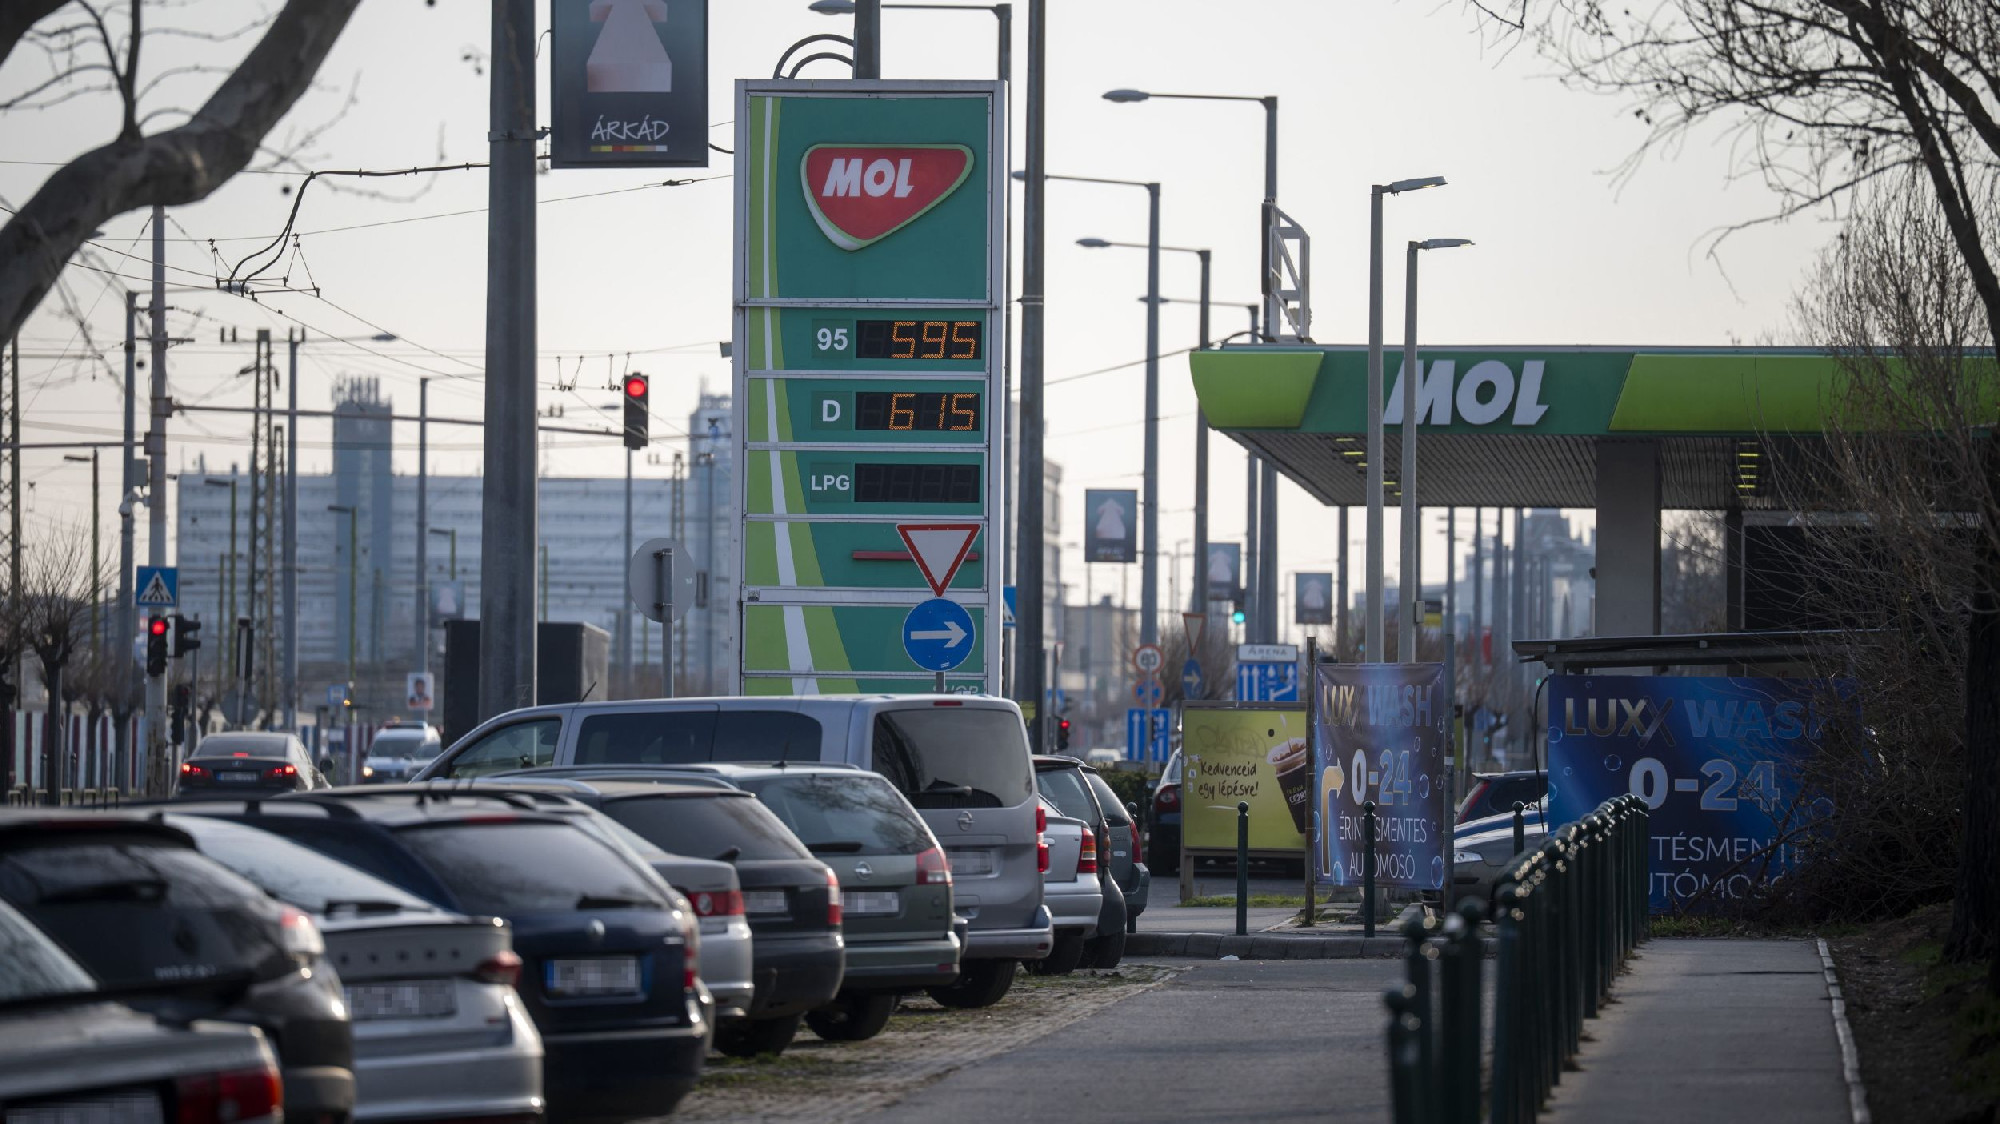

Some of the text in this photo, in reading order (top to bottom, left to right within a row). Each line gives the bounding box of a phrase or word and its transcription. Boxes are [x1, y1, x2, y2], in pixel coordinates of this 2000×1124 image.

[591, 114, 670, 141] ÁRKÁD
[822, 158, 915, 197] MOL
[816, 321, 977, 359] 95 595
[1383, 359, 1550, 425] MOL
[822, 393, 976, 430] D 615
[811, 474, 850, 491] LPG
[1368, 684, 1433, 726] WASH
[1200, 761, 1257, 777] Kedvenceid
[1352, 749, 1412, 805] 0-24
[1628, 756, 1781, 814] 0-24
[1198, 780, 1259, 800] egy lépésve!
[1339, 810, 1427, 843] ÉRINSMENTES
[1349, 848, 1416, 880] AUÓMOSÓ
[1650, 831, 1806, 864] TÉSMENTE
